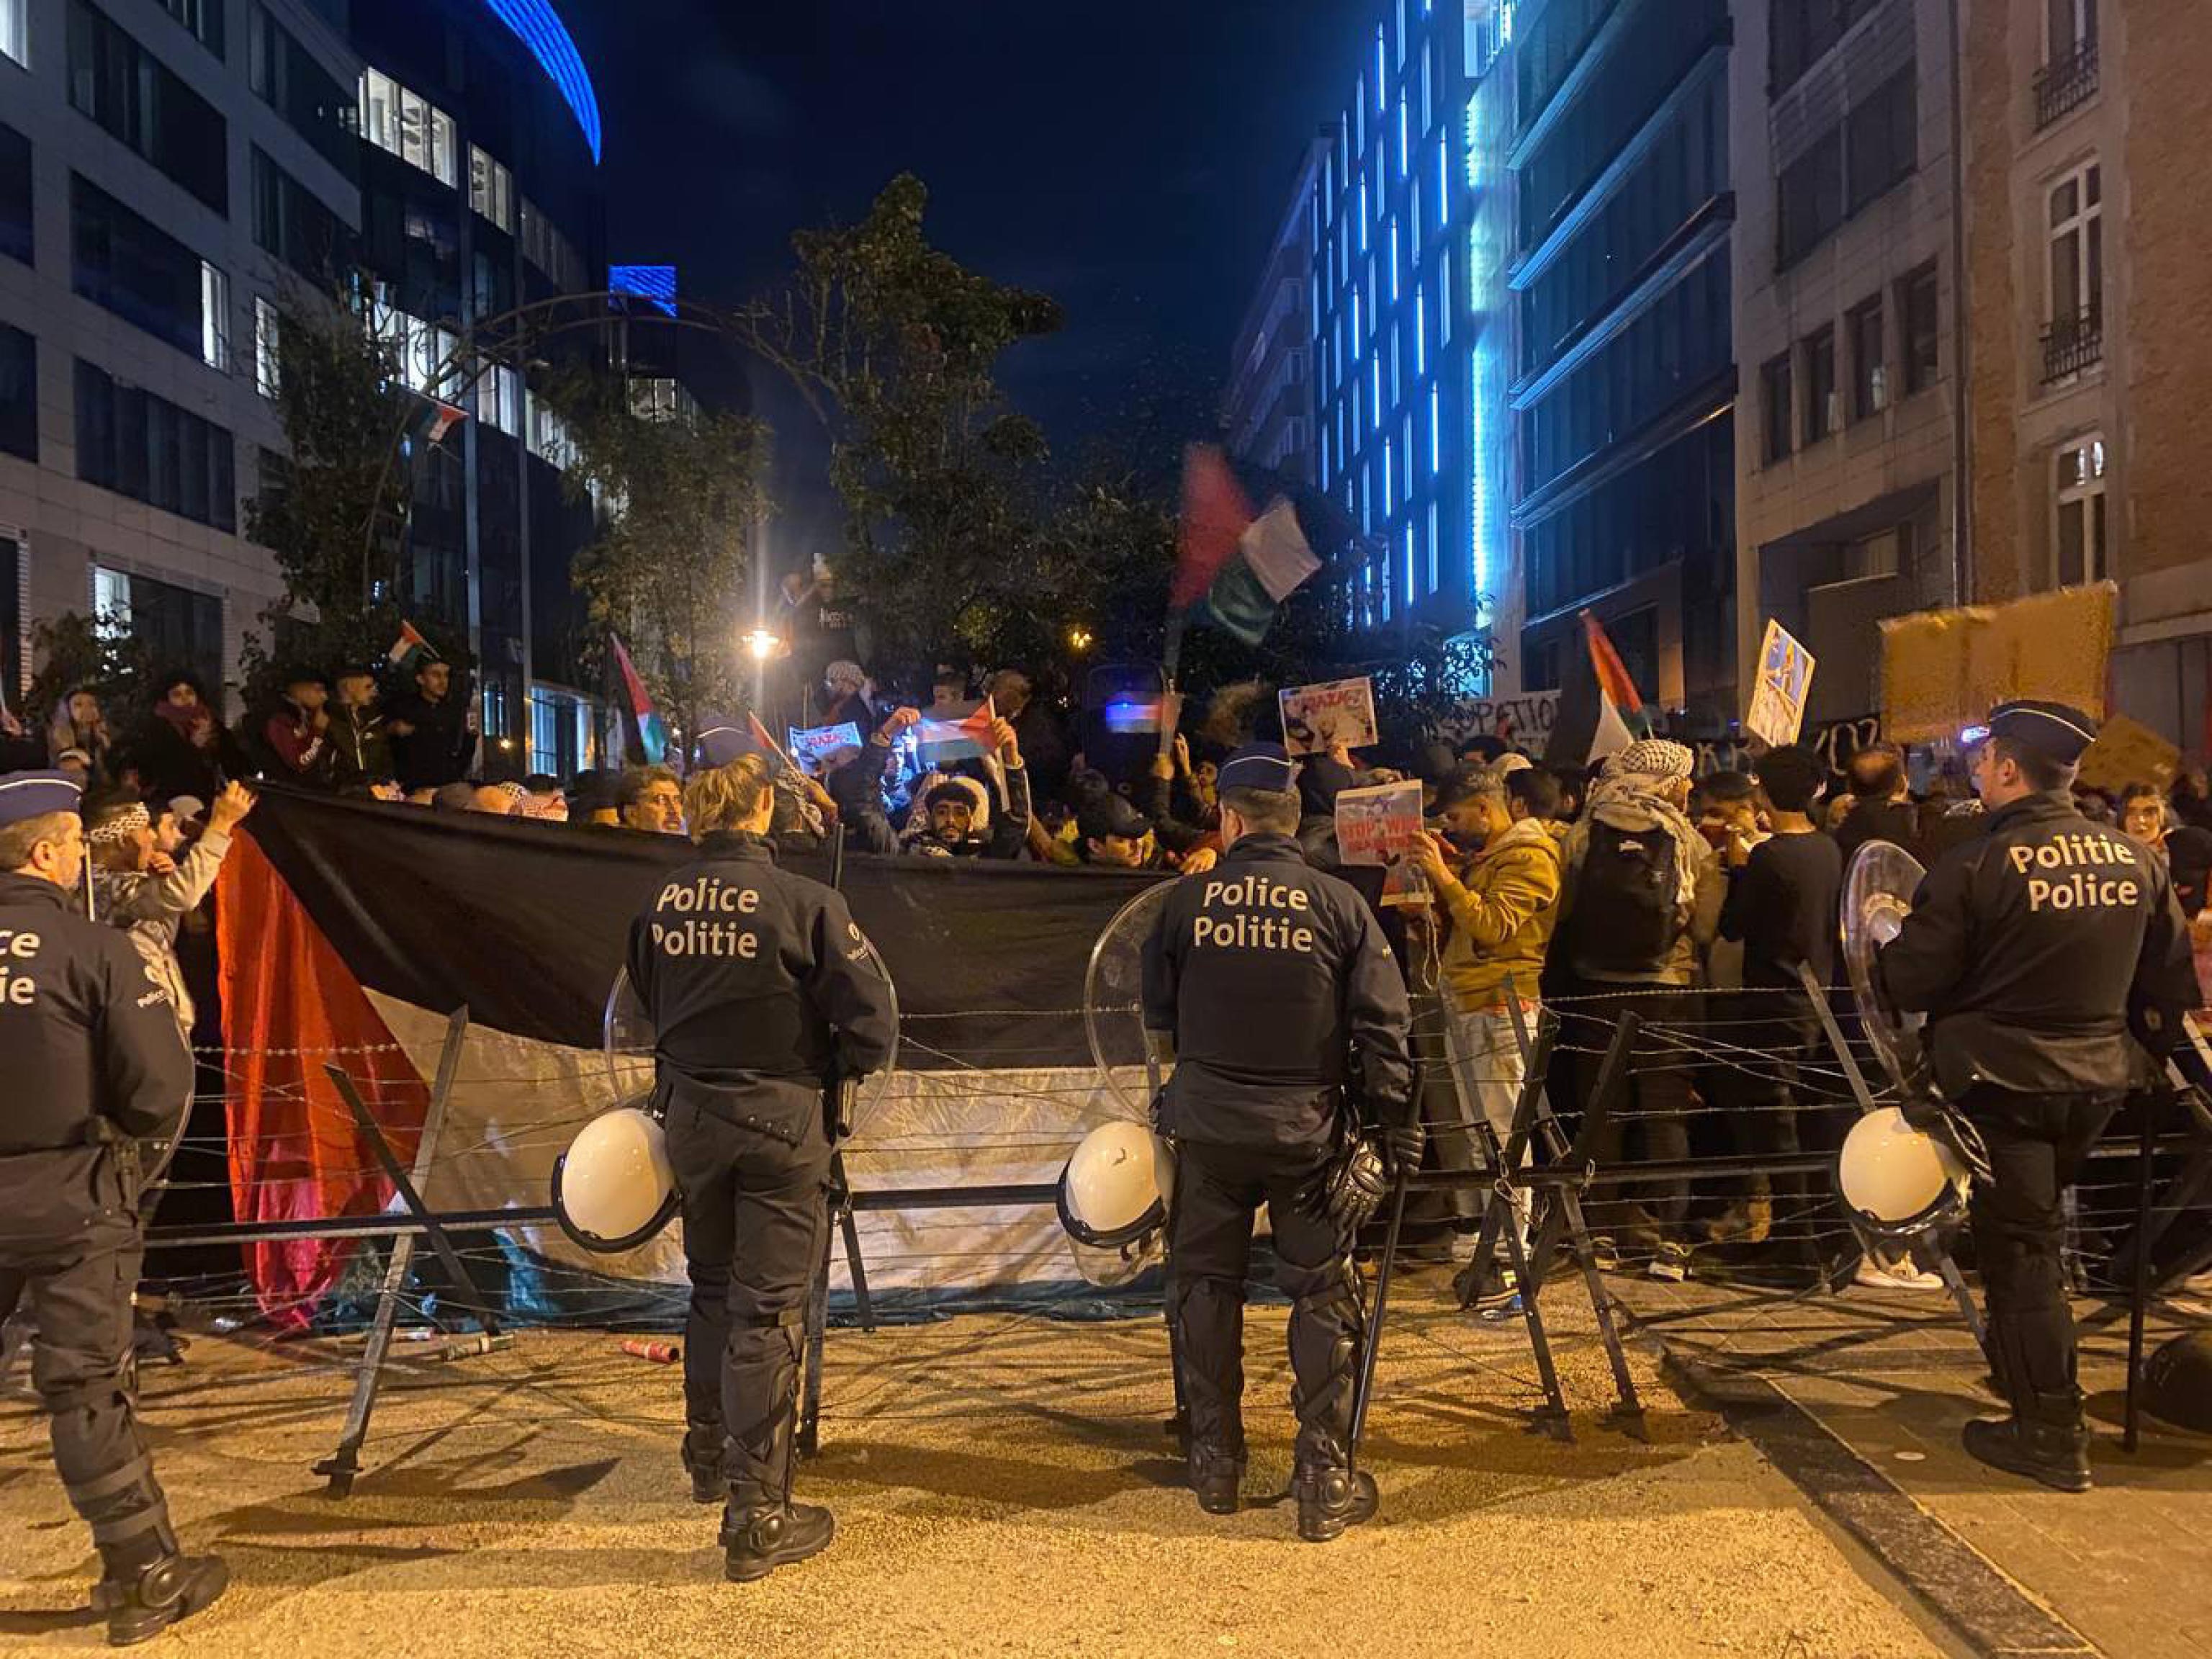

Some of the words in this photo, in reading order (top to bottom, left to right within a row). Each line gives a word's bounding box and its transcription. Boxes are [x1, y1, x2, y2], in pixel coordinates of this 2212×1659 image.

[2009, 833, 2136, 873] Politie
[656, 877, 760, 912] Police
[1202, 876, 1308, 910] Police
[2028, 873, 2139, 912] Police
[651, 920, 757, 958] Politie
[1194, 914, 1313, 951] Politie
